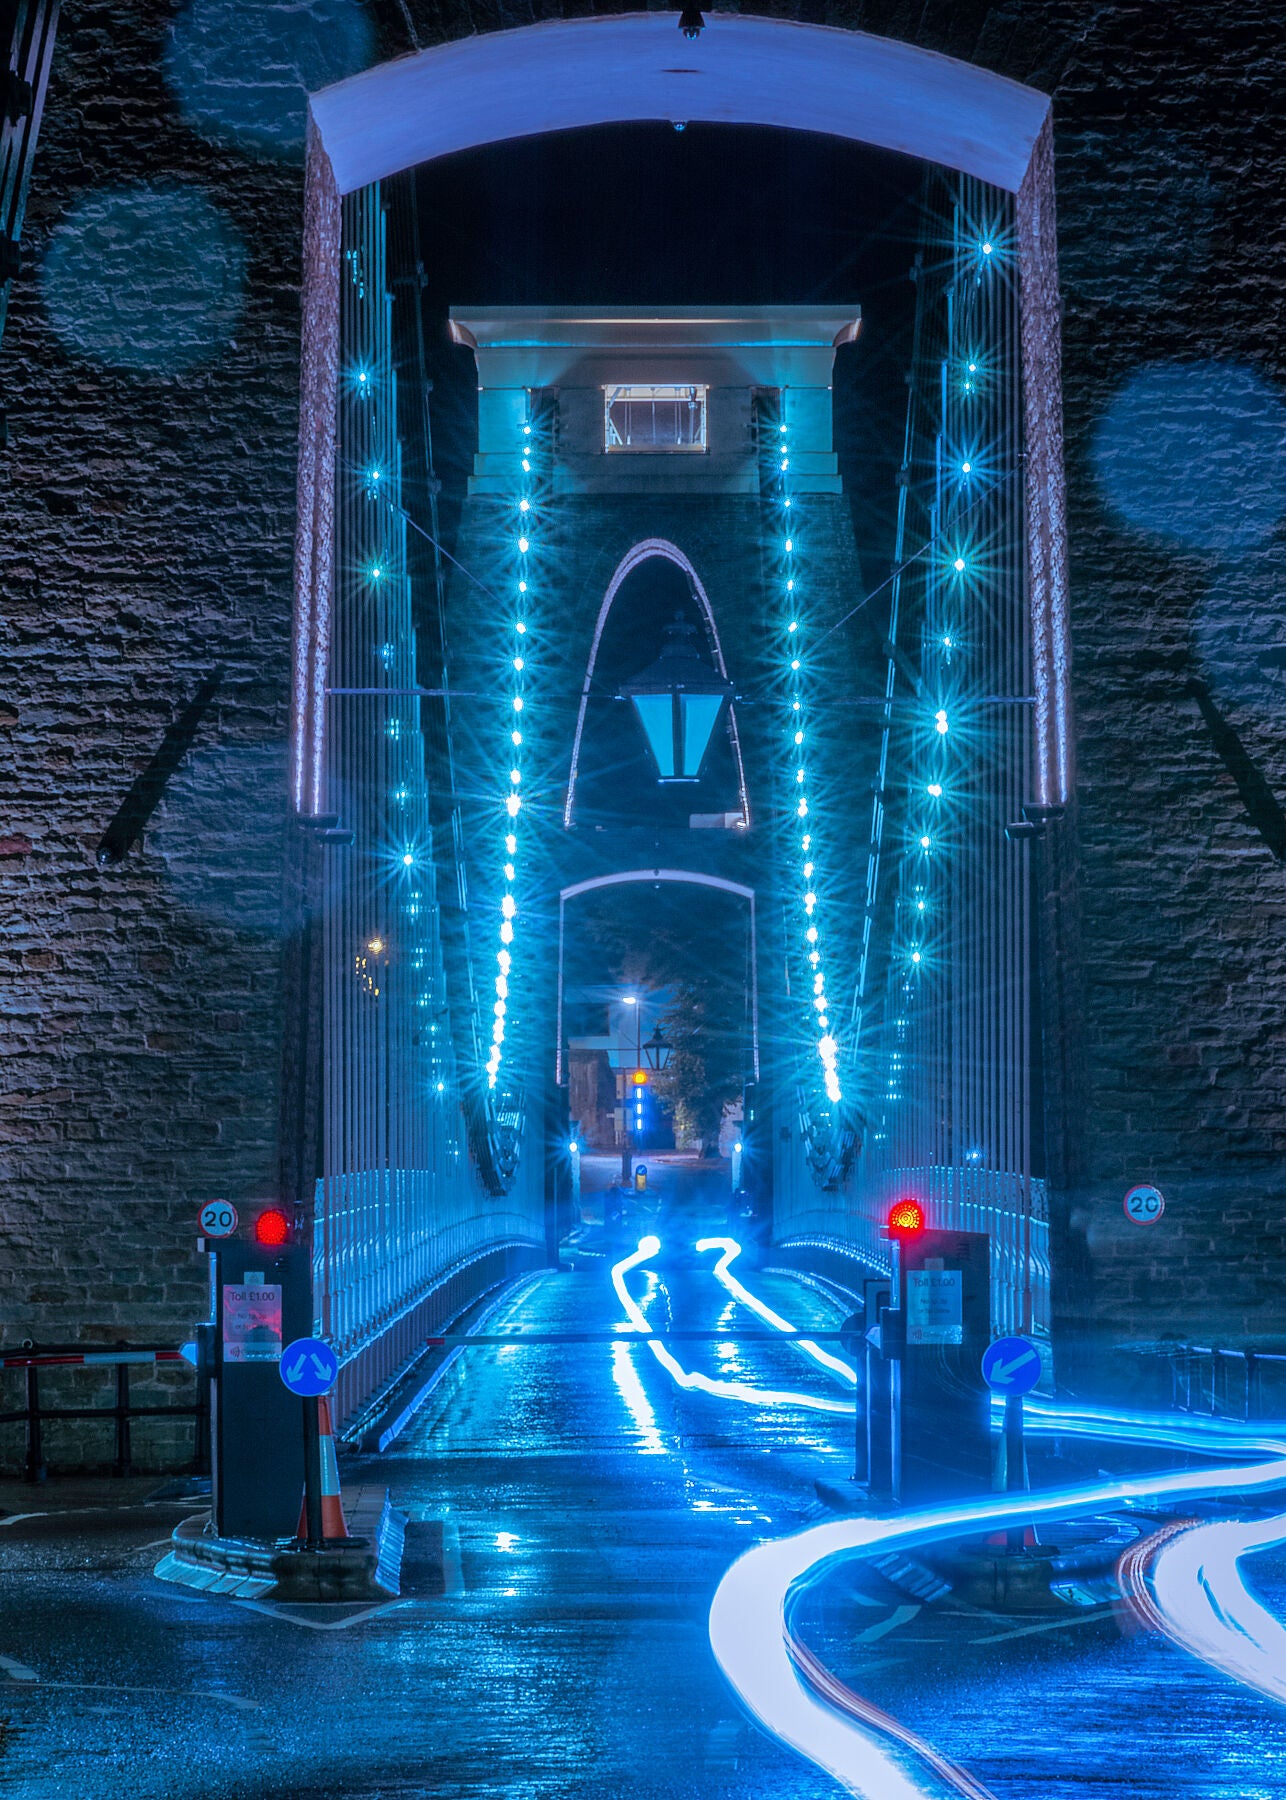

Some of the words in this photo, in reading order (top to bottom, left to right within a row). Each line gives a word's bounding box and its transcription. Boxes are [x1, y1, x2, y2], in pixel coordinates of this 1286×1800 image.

[1130, 1196, 1159, 1213] 20
[204, 1211, 233, 1228] 20
[913, 1278, 929, 1287] Toll
[931, 1278, 956, 1287] £1.00
[230, 1291, 247, 1301] Toll
[249, 1291, 275, 1301] £1.00
